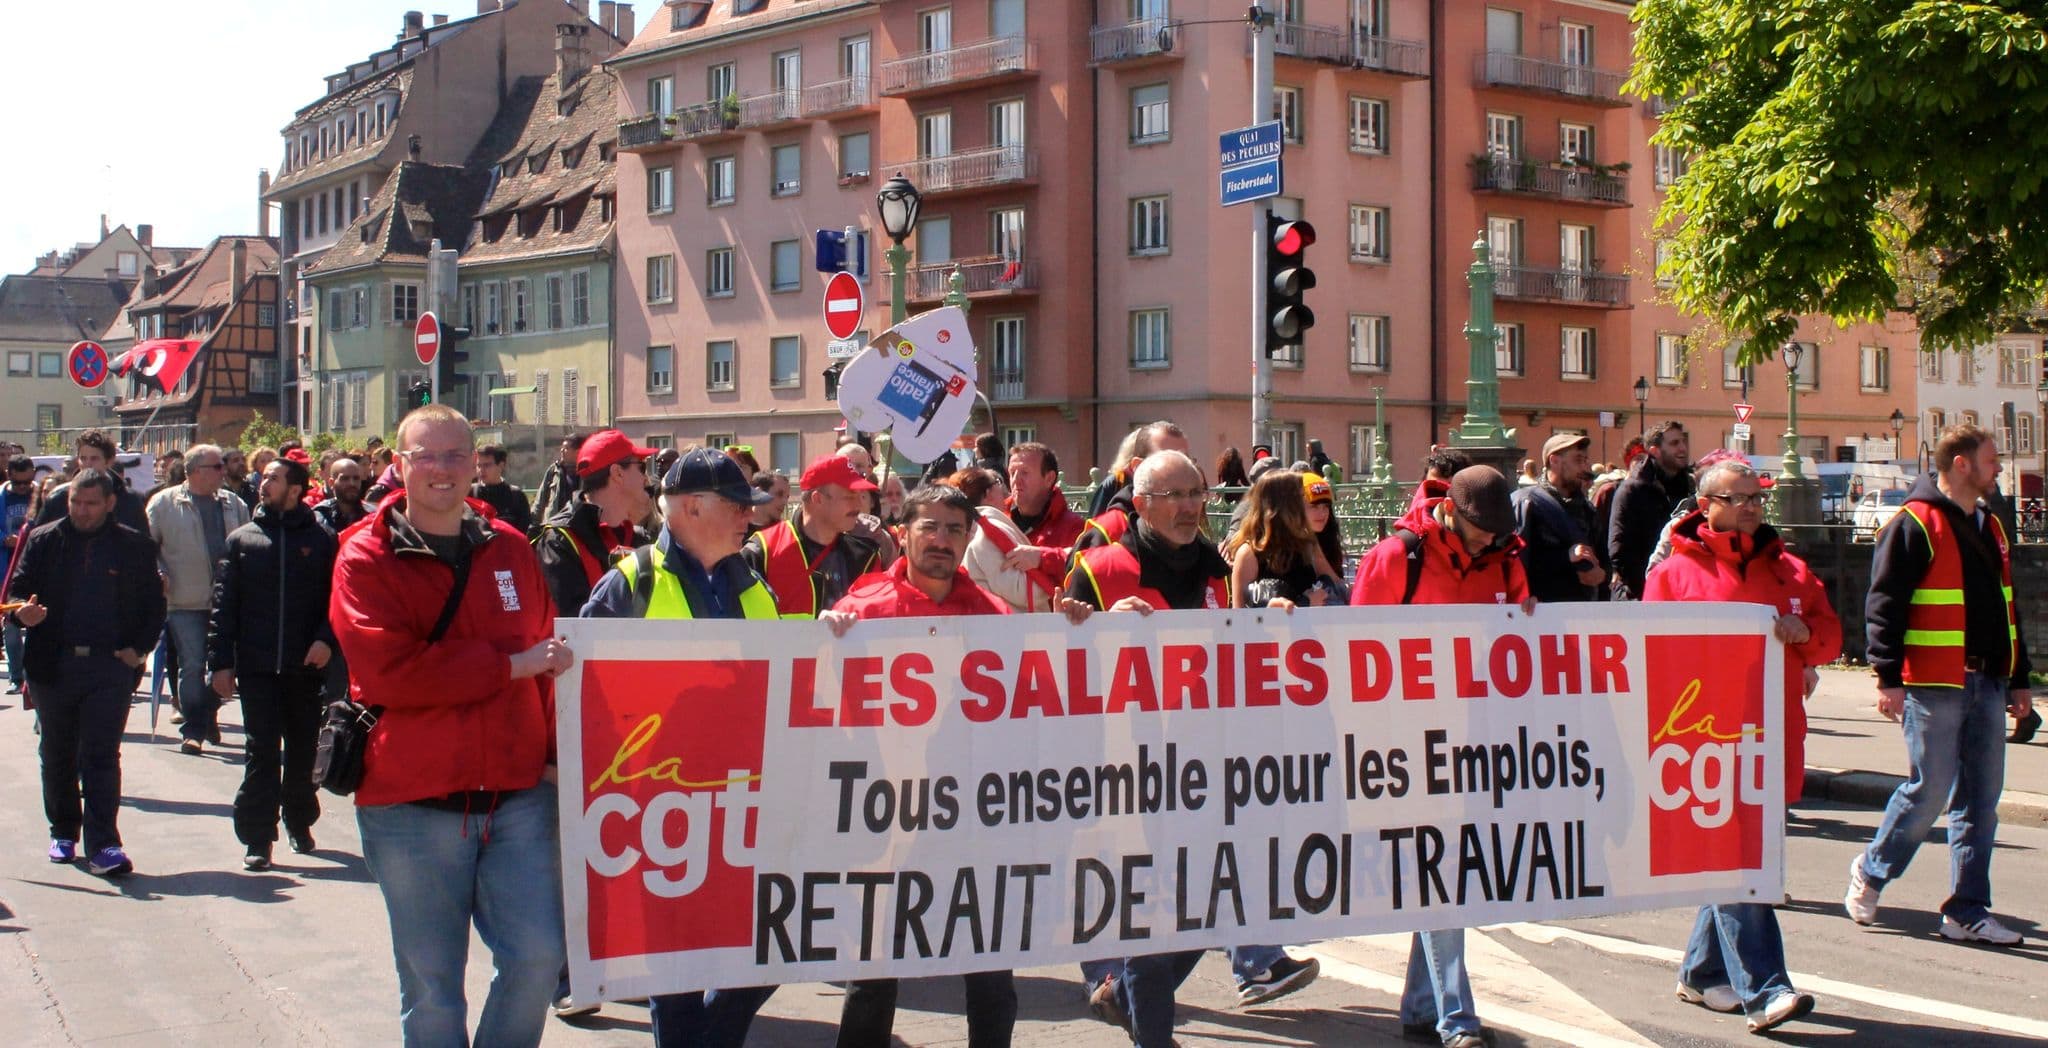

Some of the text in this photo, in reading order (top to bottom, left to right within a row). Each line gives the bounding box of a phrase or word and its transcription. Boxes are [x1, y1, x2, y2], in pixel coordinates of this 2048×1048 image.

[1221, 151, 1236, 163] DES
[1239, 131, 1258, 146] QUAI
[1226, 173, 1273, 193] Fischerstade
[890, 375, 930, 405] radio
[897, 364, 936, 395] france
[788, 633, 1631, 728] LES SALARIES DE LOHR
[1653, 678, 1765, 742] la
[590, 713, 762, 793] la
[829, 724, 1606, 833] Tous ensemble pour les Emplois,
[1648, 723, 1765, 829] cgt
[582, 769, 761, 898] cgt
[755, 820, 1606, 966] RETRAIT DE LA LOI TRAVAIL
